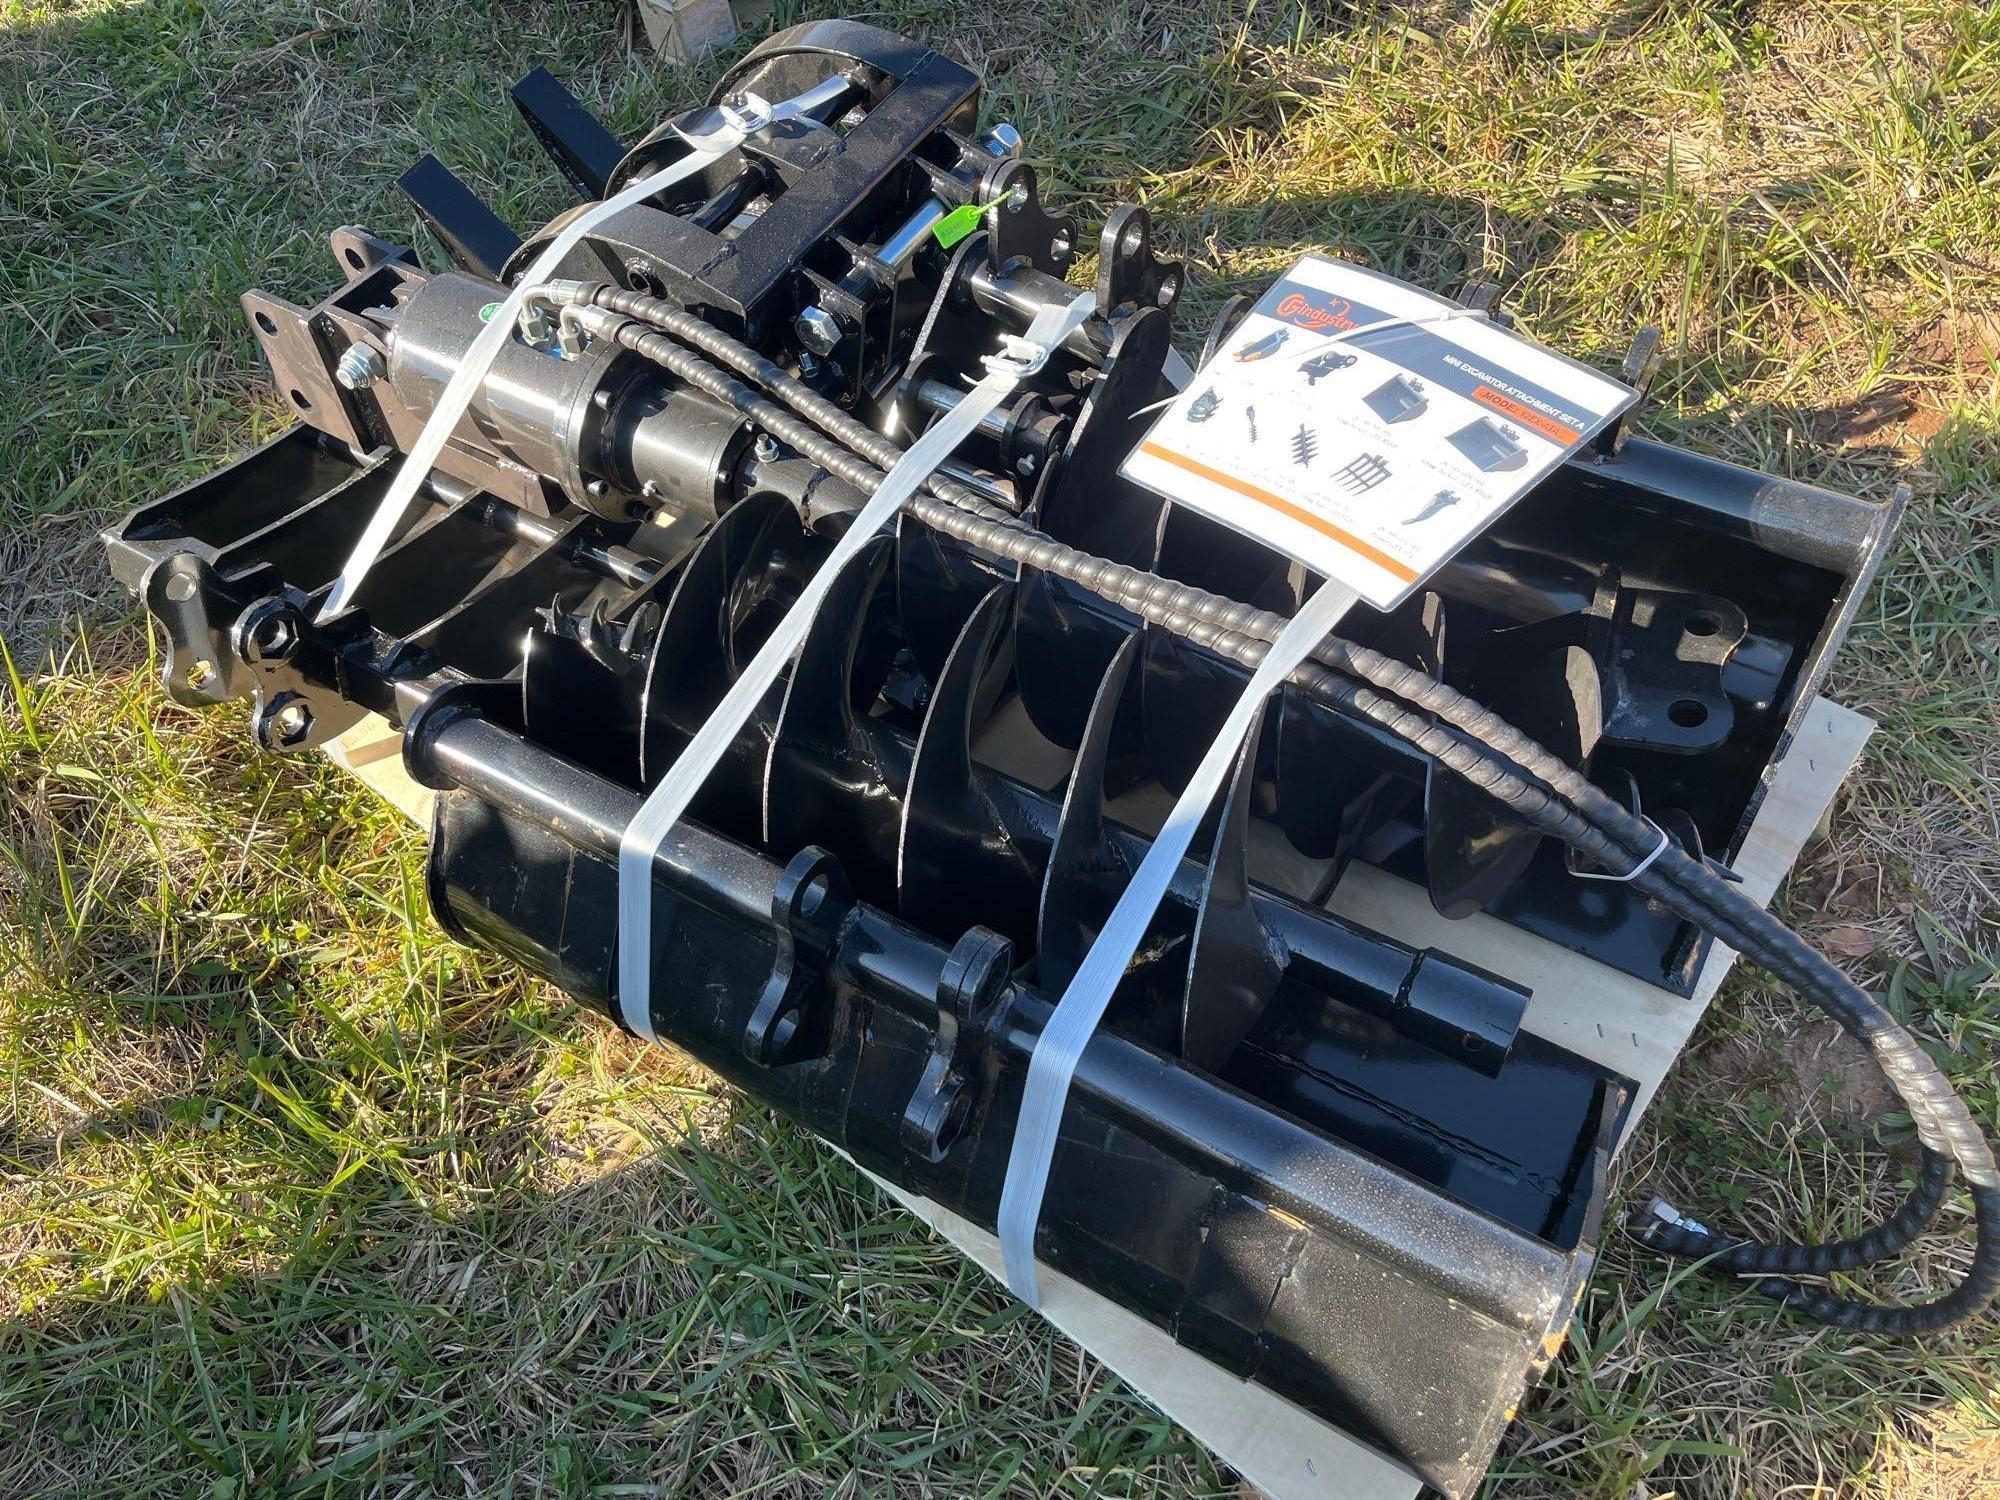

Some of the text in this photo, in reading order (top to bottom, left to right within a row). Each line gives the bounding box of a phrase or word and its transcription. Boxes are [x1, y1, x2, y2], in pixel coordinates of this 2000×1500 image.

[1442, 354, 1585, 430] MINI EXCAVATOR ATTACHMENT SET A
